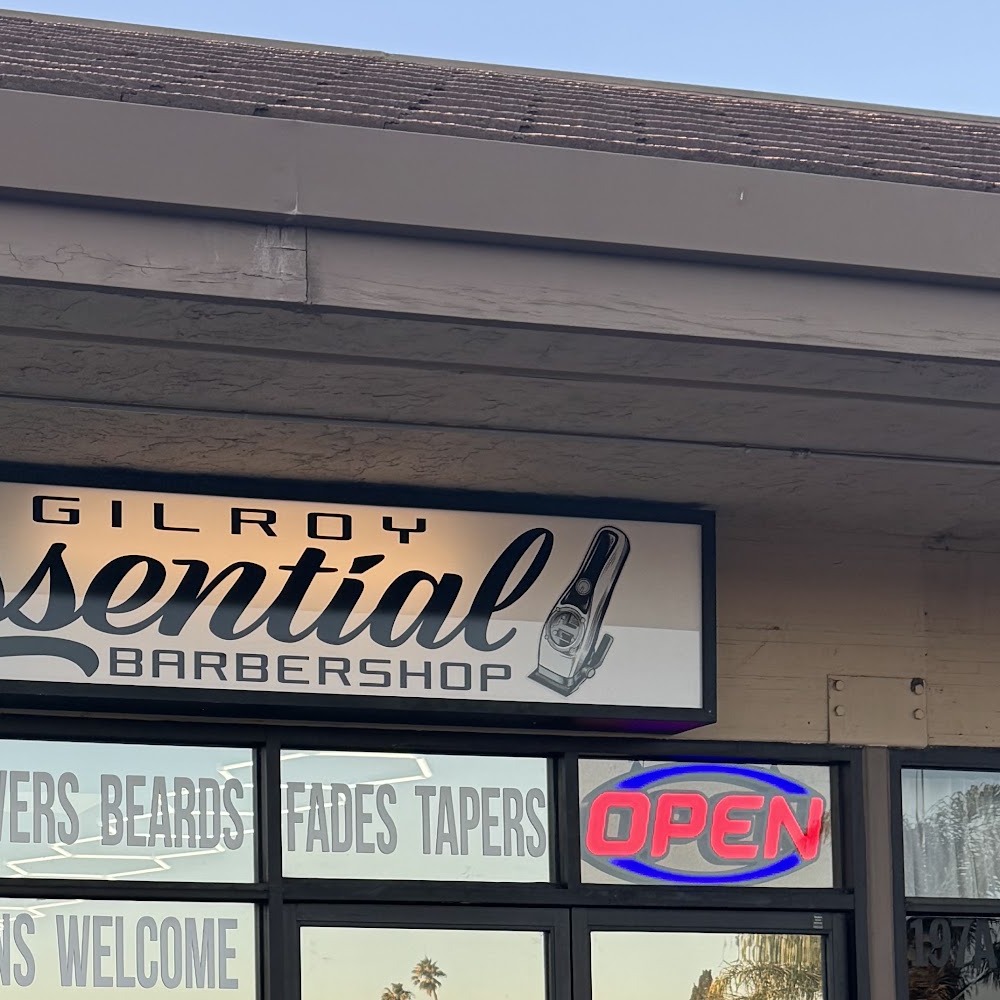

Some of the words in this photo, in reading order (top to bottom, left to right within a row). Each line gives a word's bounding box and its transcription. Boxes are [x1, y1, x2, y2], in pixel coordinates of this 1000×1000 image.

[32, 495, 427, 544] GILROY
[110, 647, 511, 692] BARBERSHOP
[101, 774, 244, 850] BEARDS
[287, 781, 397, 855] FADES
[414, 785, 546, 858] TAPERS
[585, 791, 824, 861] OPEN
[56, 914, 239, 989] WELCOME
[910, 918, 997, 969] 197A
